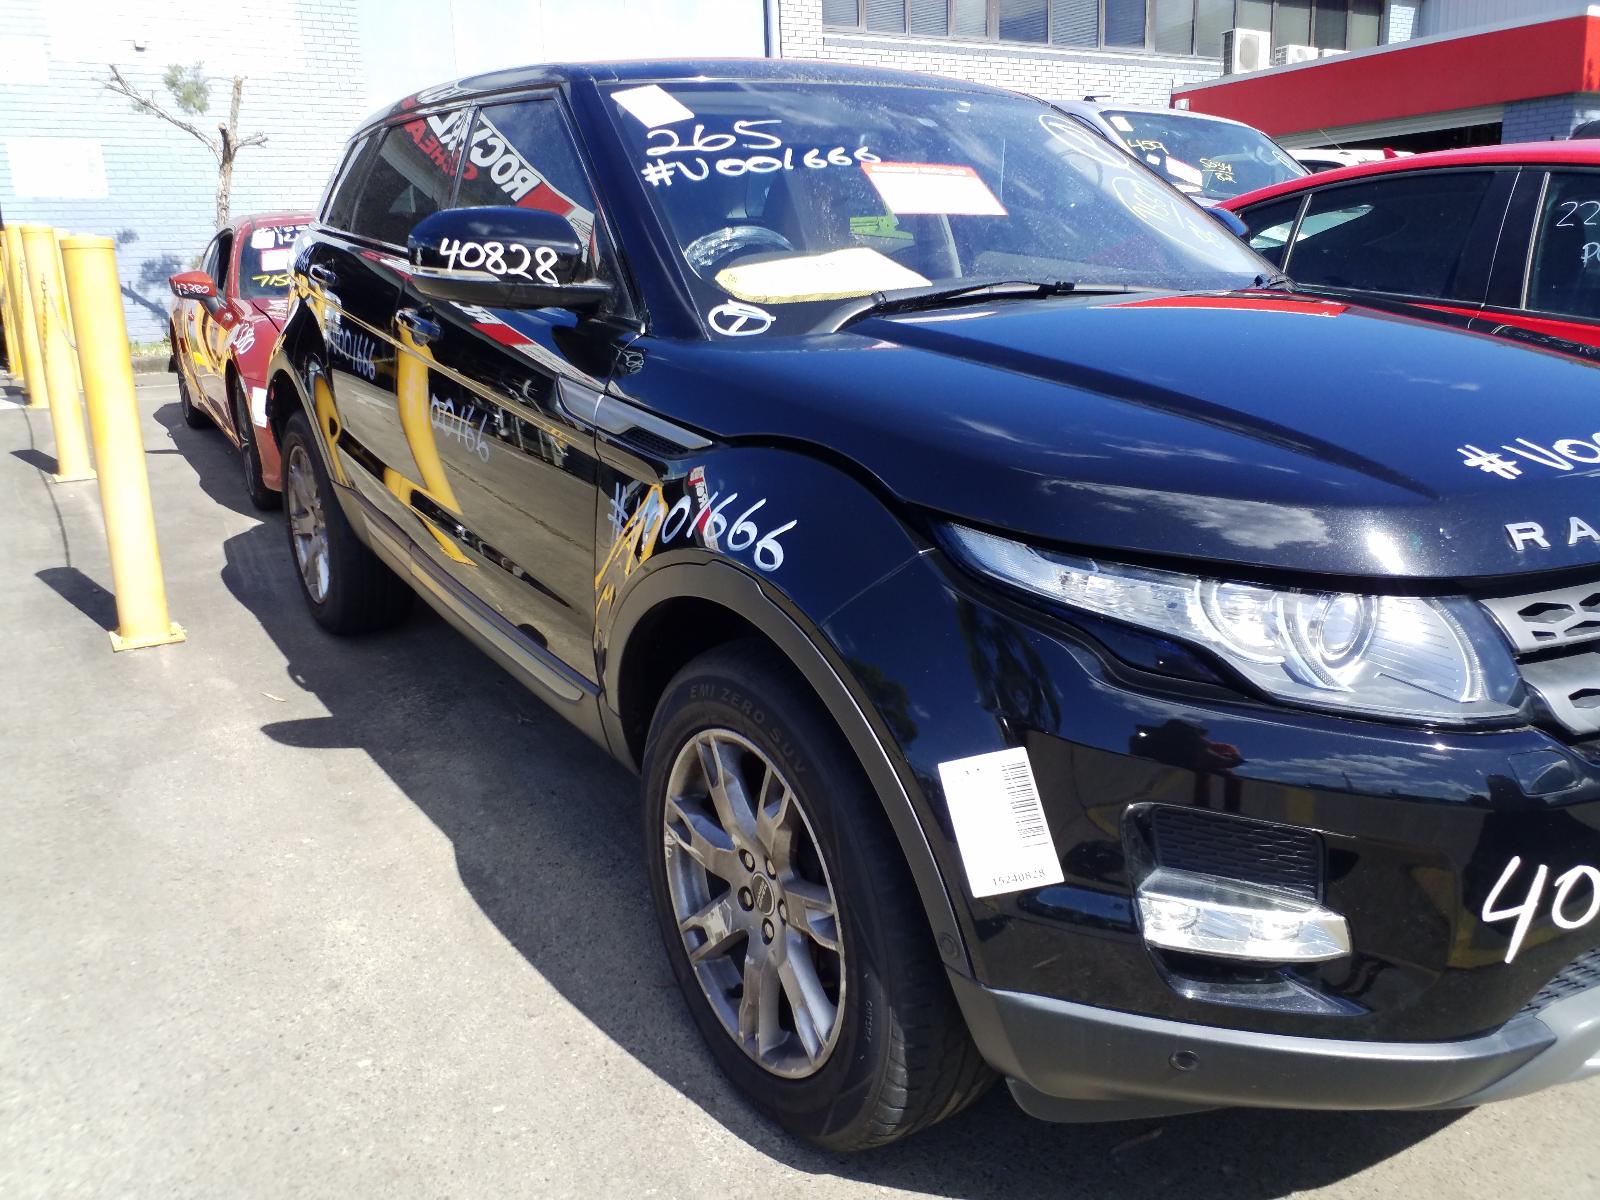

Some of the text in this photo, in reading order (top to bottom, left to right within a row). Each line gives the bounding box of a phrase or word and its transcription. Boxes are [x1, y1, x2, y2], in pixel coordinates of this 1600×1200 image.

[645, 119, 783, 156] 265
[439, 237, 561, 287] 40828
[719, 687, 767, 725] ZERO
[1481, 855, 1600, 964] 40
